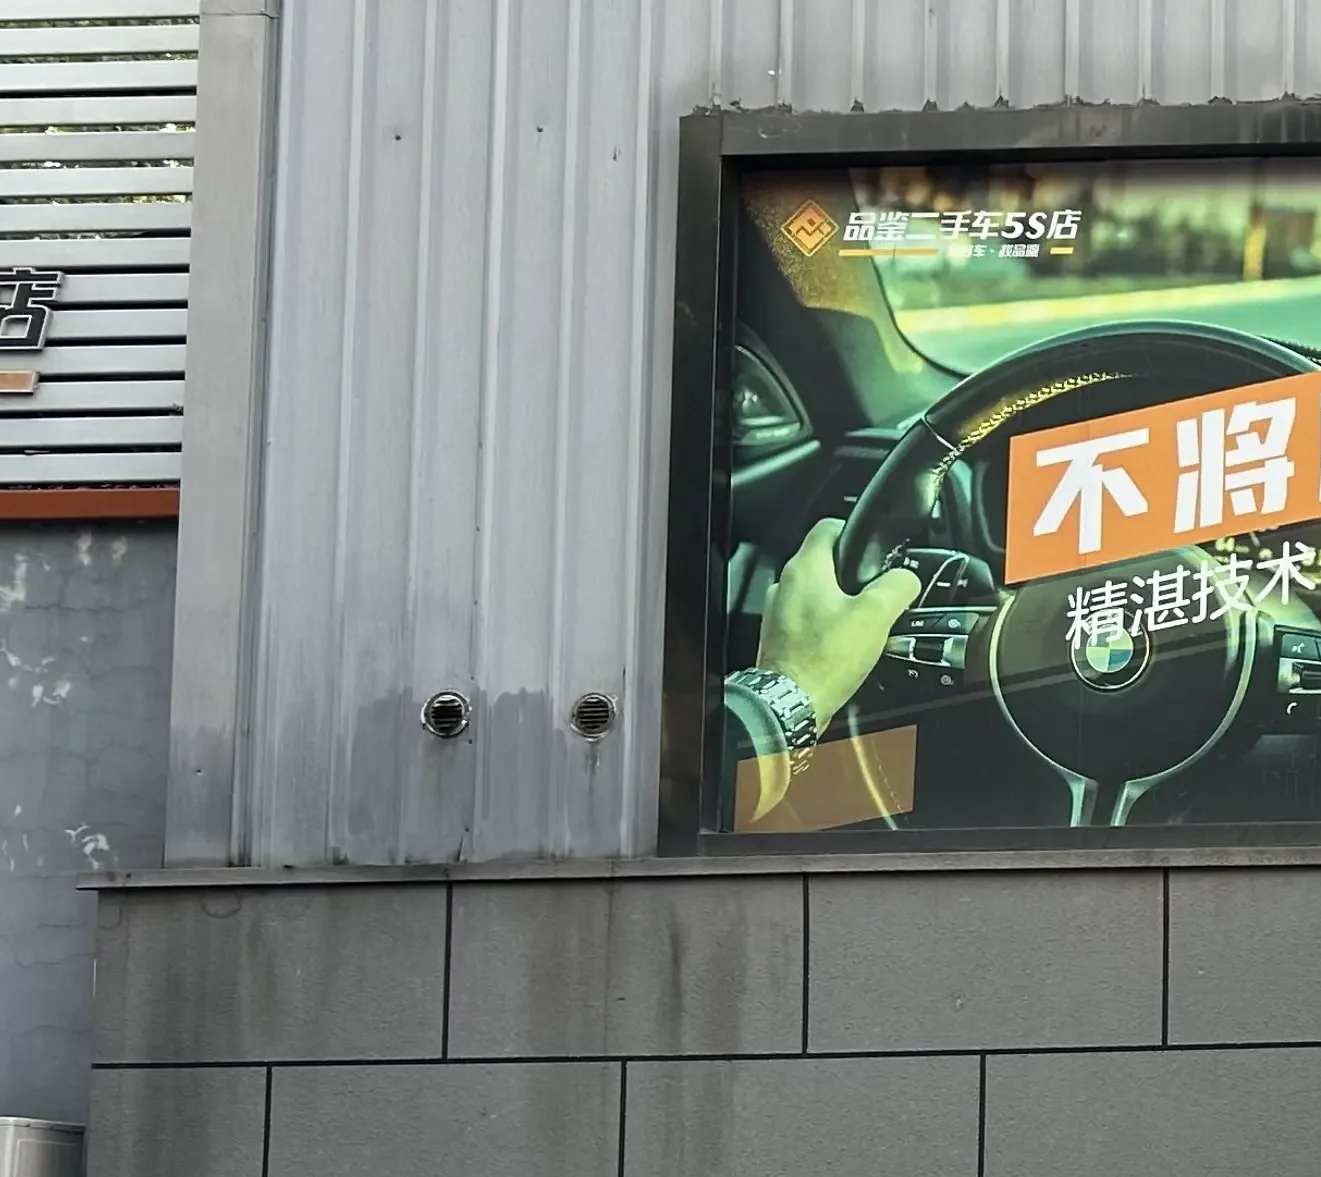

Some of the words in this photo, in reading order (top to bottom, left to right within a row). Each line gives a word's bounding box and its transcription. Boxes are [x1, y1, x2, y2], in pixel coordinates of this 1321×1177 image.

[843, 209, 1082, 241] 品鉴二手车5S店
[1065, 541, 1318, 650] 精湛技术
